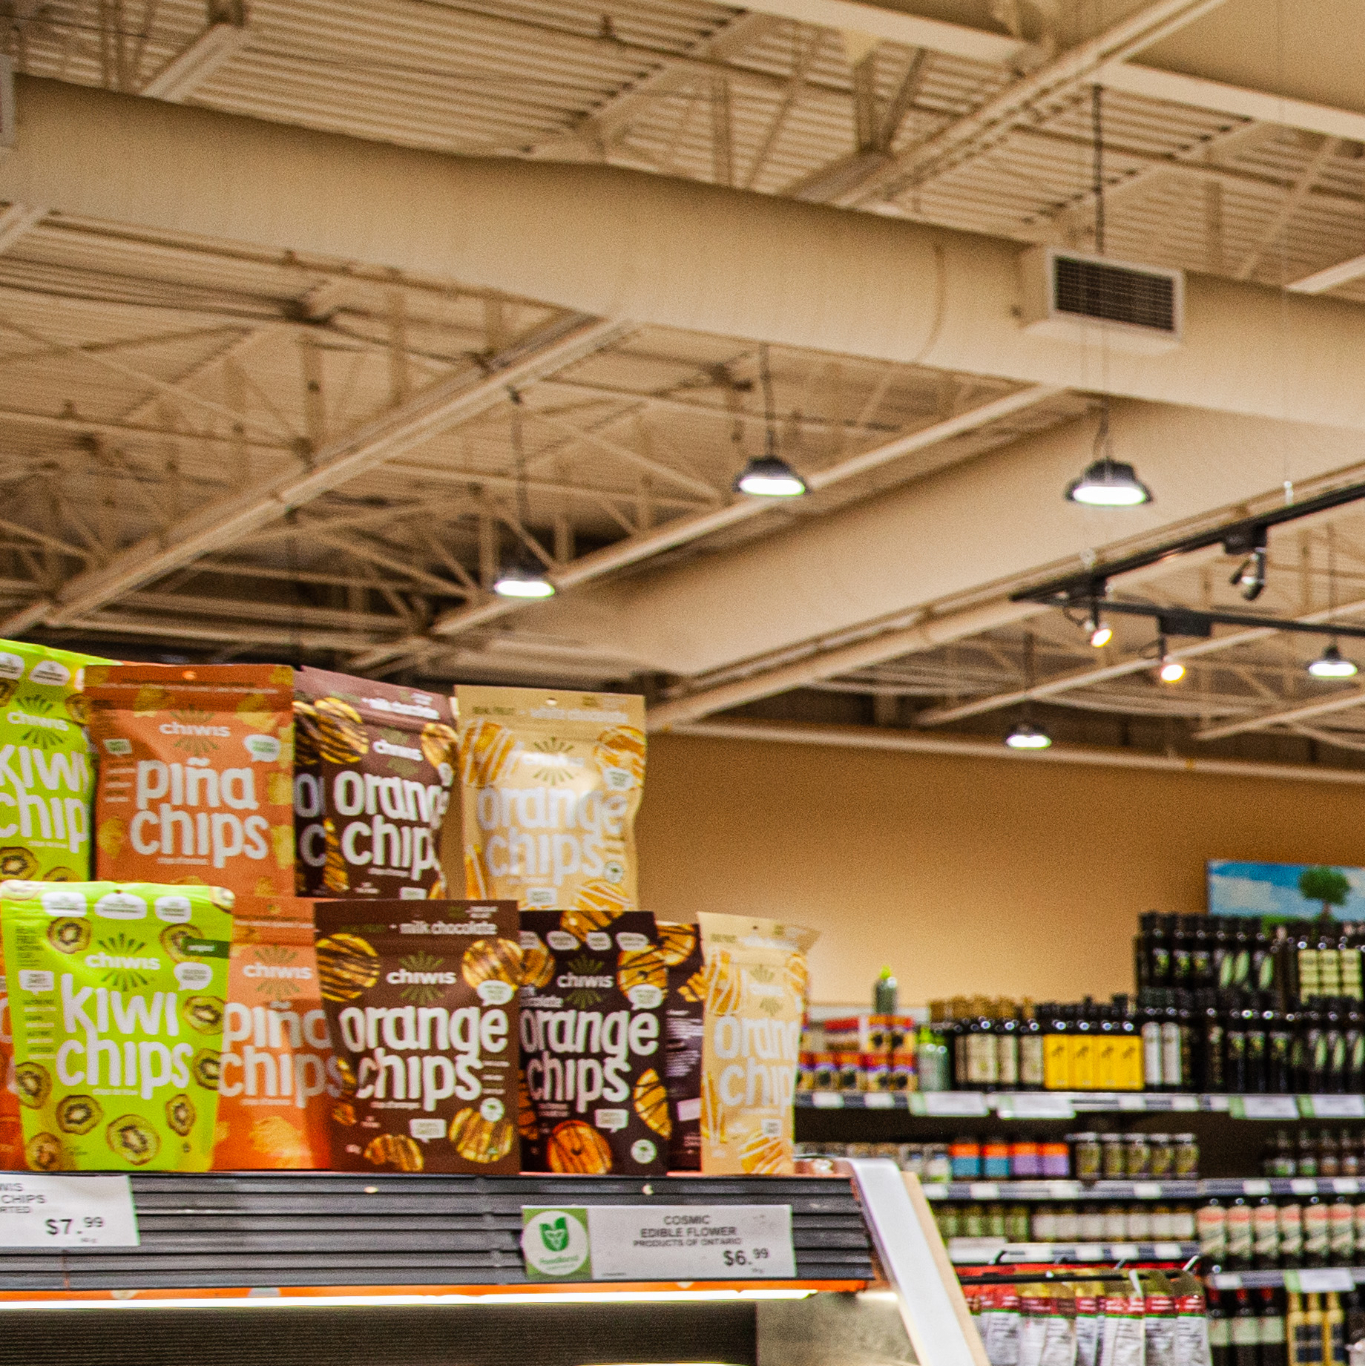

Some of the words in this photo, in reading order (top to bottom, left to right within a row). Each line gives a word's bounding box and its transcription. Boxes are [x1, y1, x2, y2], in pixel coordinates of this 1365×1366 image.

[136, 756, 260, 811] piña
[0, 783, 90, 854] chip
[129, 803, 270, 869] chips
[477, 786, 628, 845] orange
[341, 814, 443, 882] chip
[484, 827, 605, 887] chips
[400, 920, 430, 934] milk
[431, 921, 498, 935] chocolate
[85, 952, 162, 972] chiwis
[243, 961, 313, 980] chiwis
[386, 968, 458, 985] chiwis
[557, 971, 614, 989] chiwis
[61, 973, 178, 1037] kiwi
[222, 1000, 333, 1054] piña
[339, 1005, 509, 1058] orange
[520, 1009, 660, 1060] orange
[56, 1028, 194, 1100] chips
[356, 1047, 483, 1112] chips
[526, 1051, 632, 1113] chips
[719, 1057, 795, 1117] chip
[1, 1194, 47, 1205] CHIPS
[45, 1216, 105, 1236] $7.99
[663, 1215, 711, 1226] COSMIC
[640, 1228, 684, 1239] EDIBLE
[686, 1227, 737, 1238] FLOWER
[722, 1248, 770, 1267] $6.99
